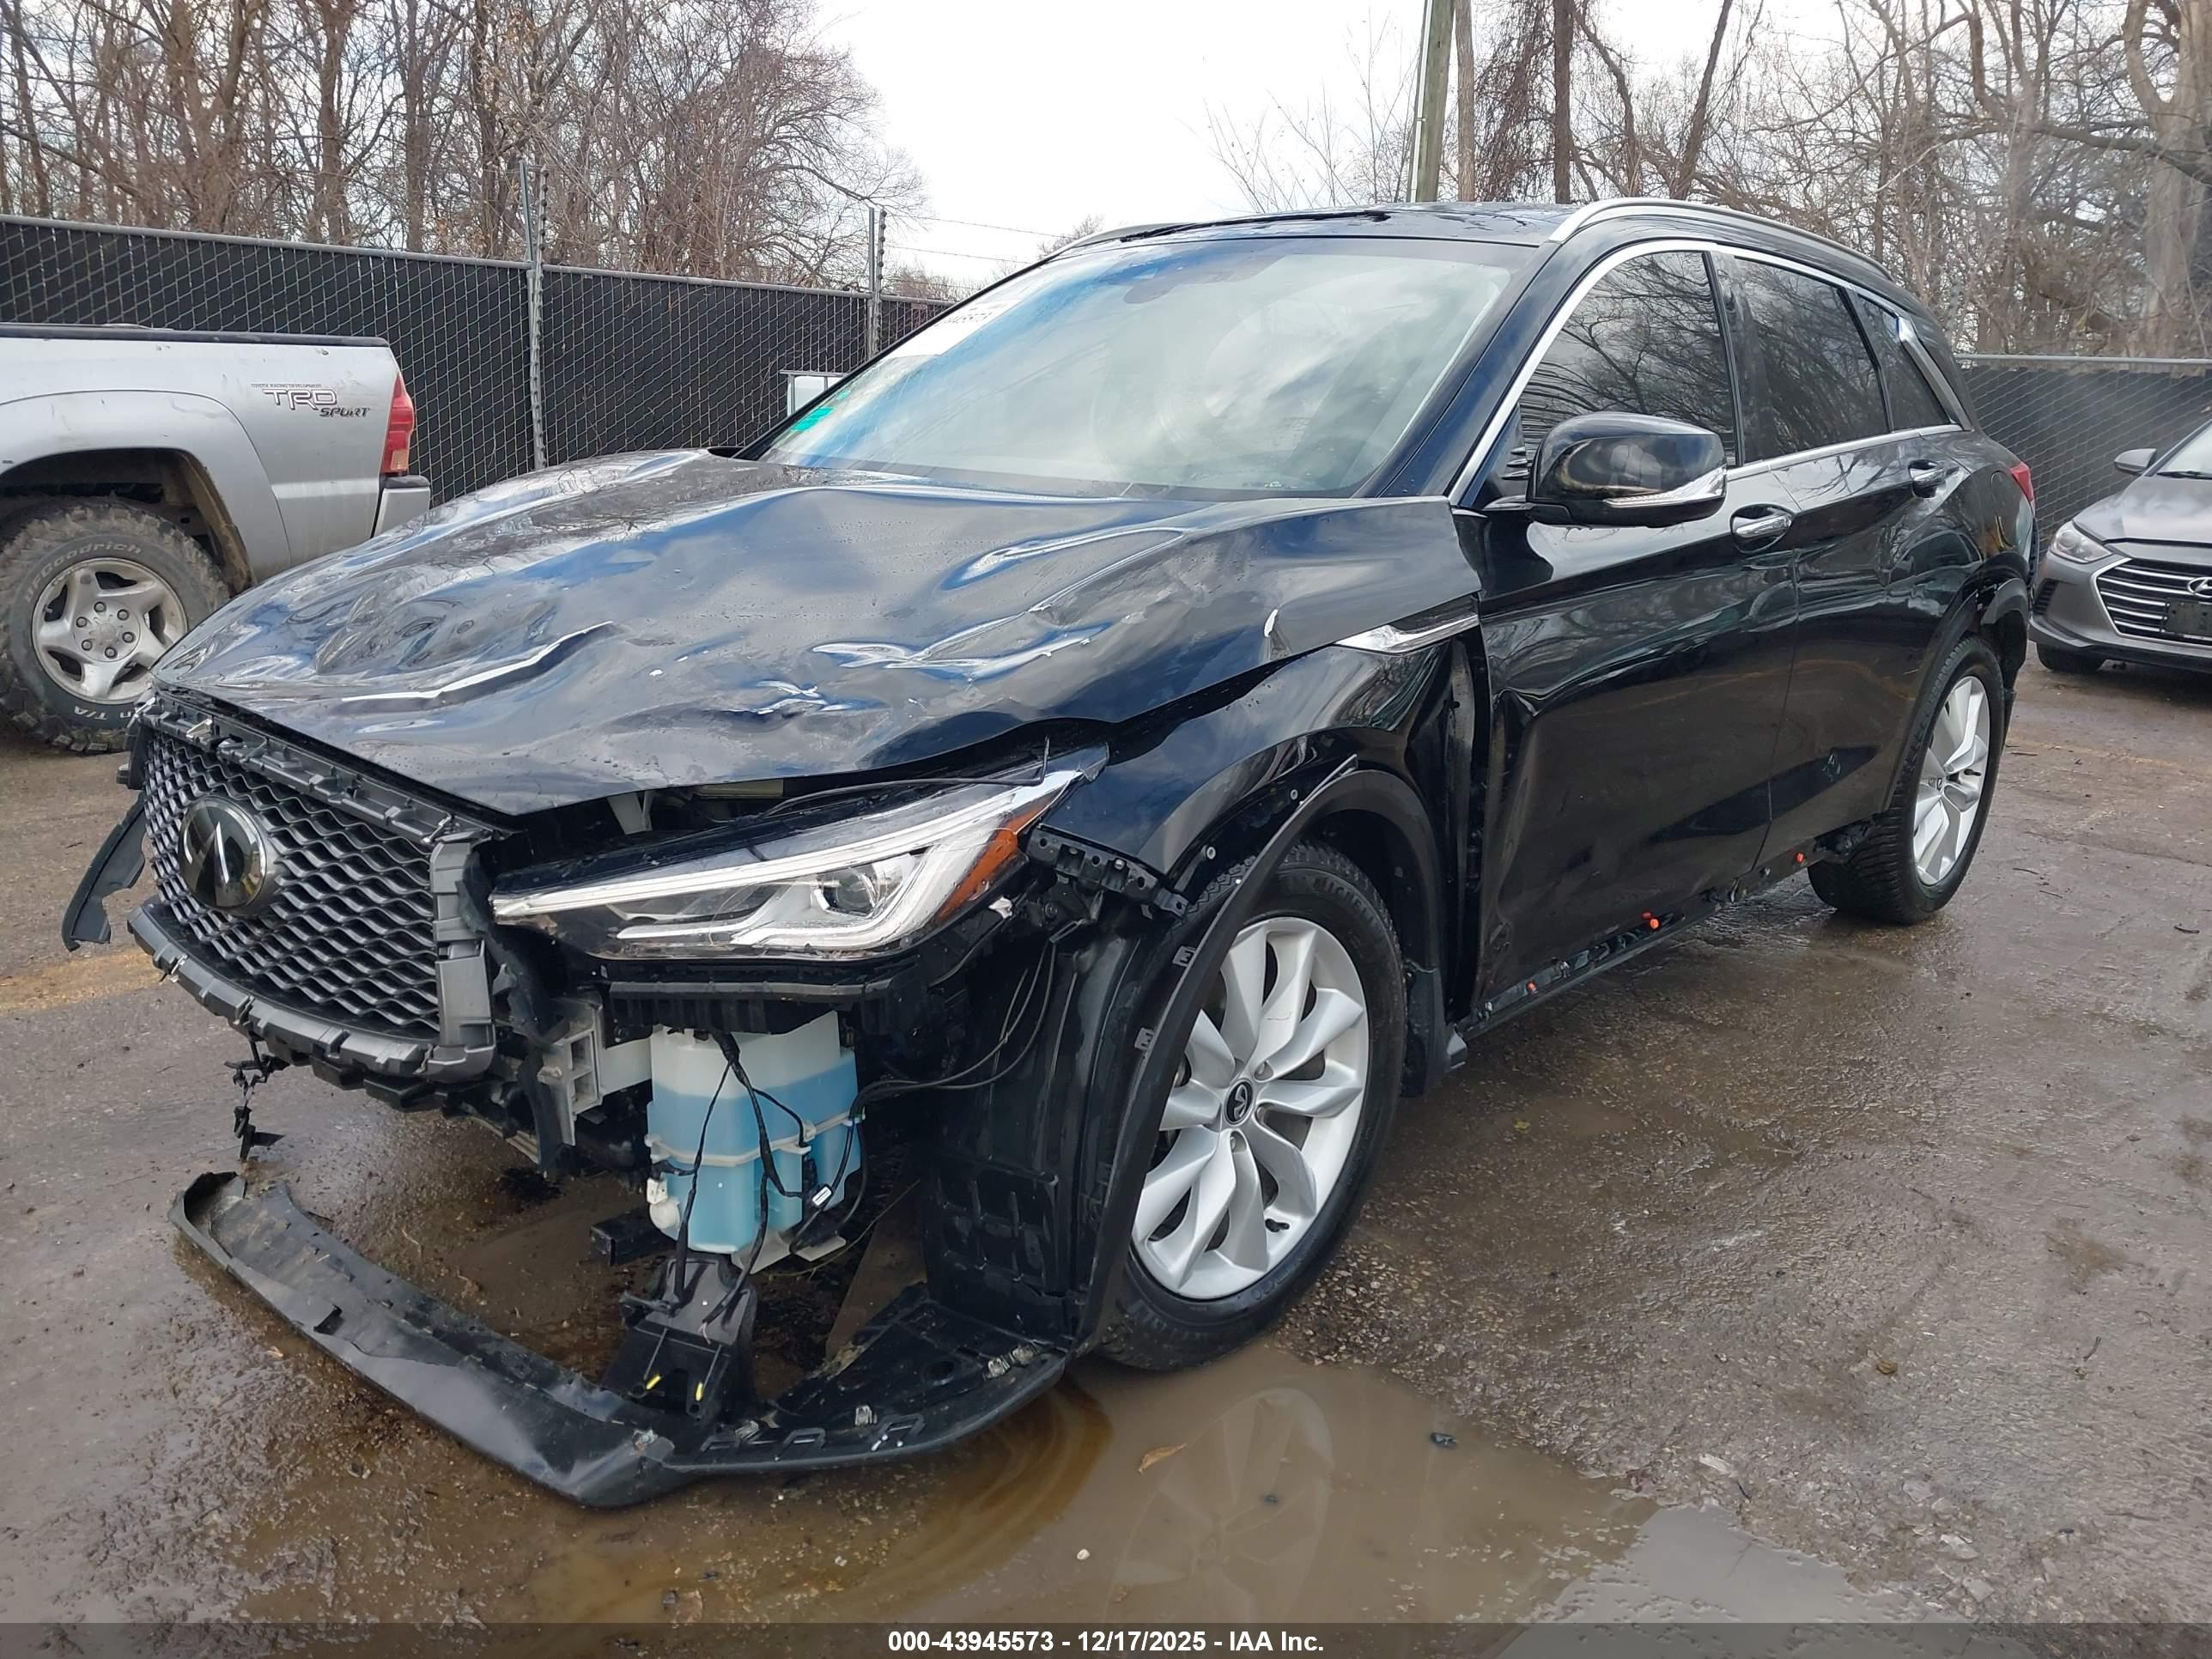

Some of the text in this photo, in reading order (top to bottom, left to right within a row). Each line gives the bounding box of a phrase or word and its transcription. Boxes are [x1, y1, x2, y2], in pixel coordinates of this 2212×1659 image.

[263, 388, 337, 410] TRD
[319, 407, 369, 417] SPORT
[74, 705, 108, 720] T/A
